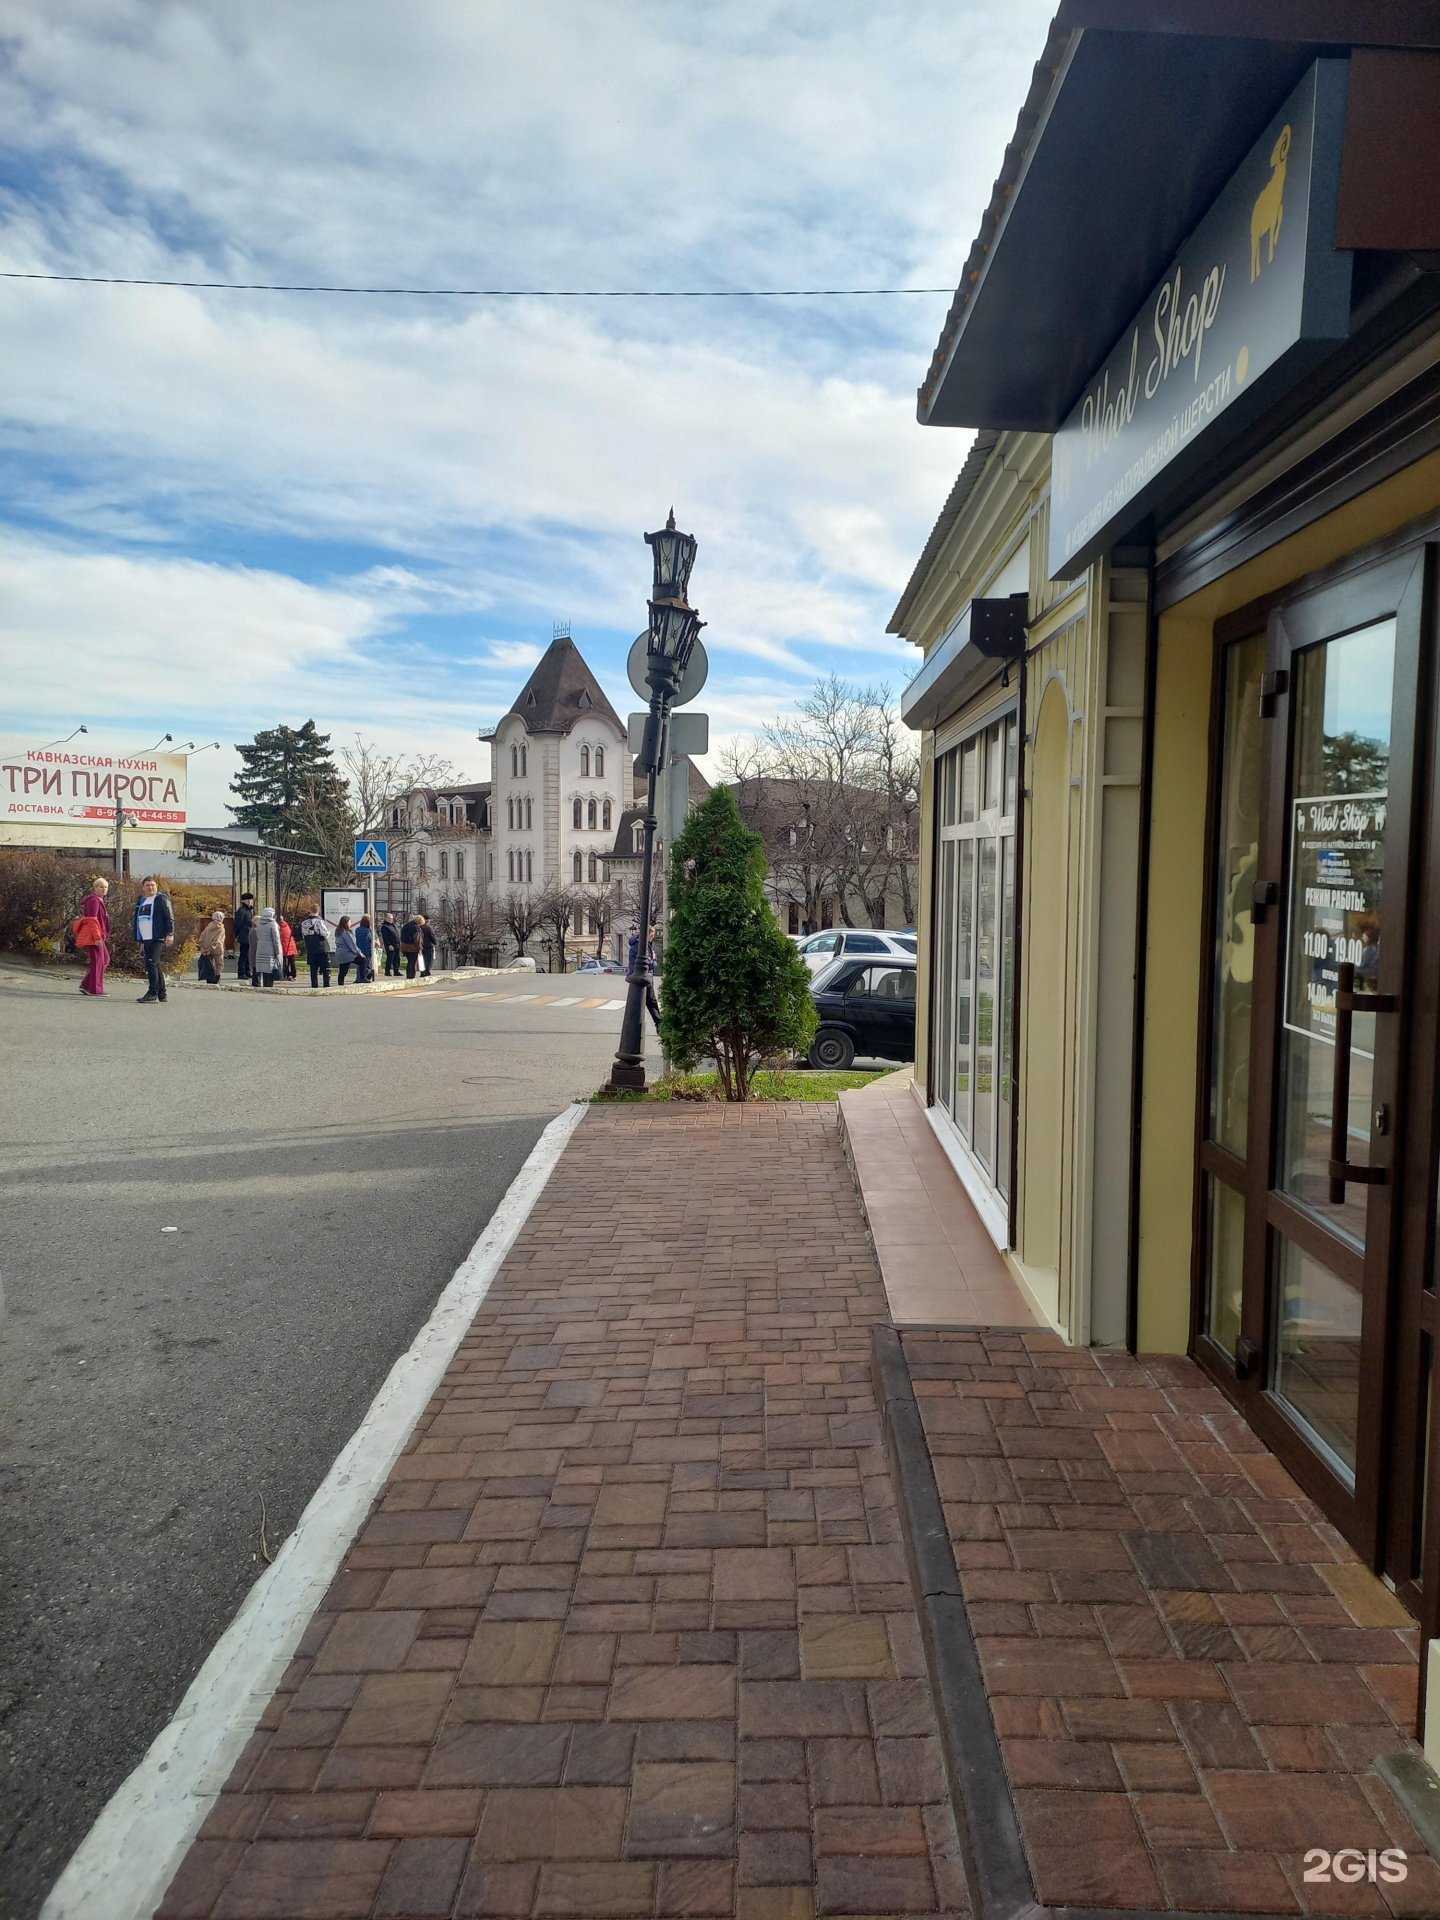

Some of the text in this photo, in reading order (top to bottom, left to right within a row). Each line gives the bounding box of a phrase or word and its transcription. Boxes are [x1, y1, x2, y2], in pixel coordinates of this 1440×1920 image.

[1081, 263, 1227, 466] Wool Shop
[1180, 364, 1232, 440] ШЕРСТИ
[27, 750, 157, 771] КАВКАЗСКАЯ КУХНЯ
[2, 765, 179, 803] ТРИ ПИРОГА
[8, 803, 64, 815] ДОСТАВКА
[1310, 803, 1369, 840] Wool Shop
[1305, 887, 1366, 912] РЕЖИМ РАБОТЫ:
[1303, 931, 1328, 960] 11.00
[1334, 936, 1363, 967] 19.00
